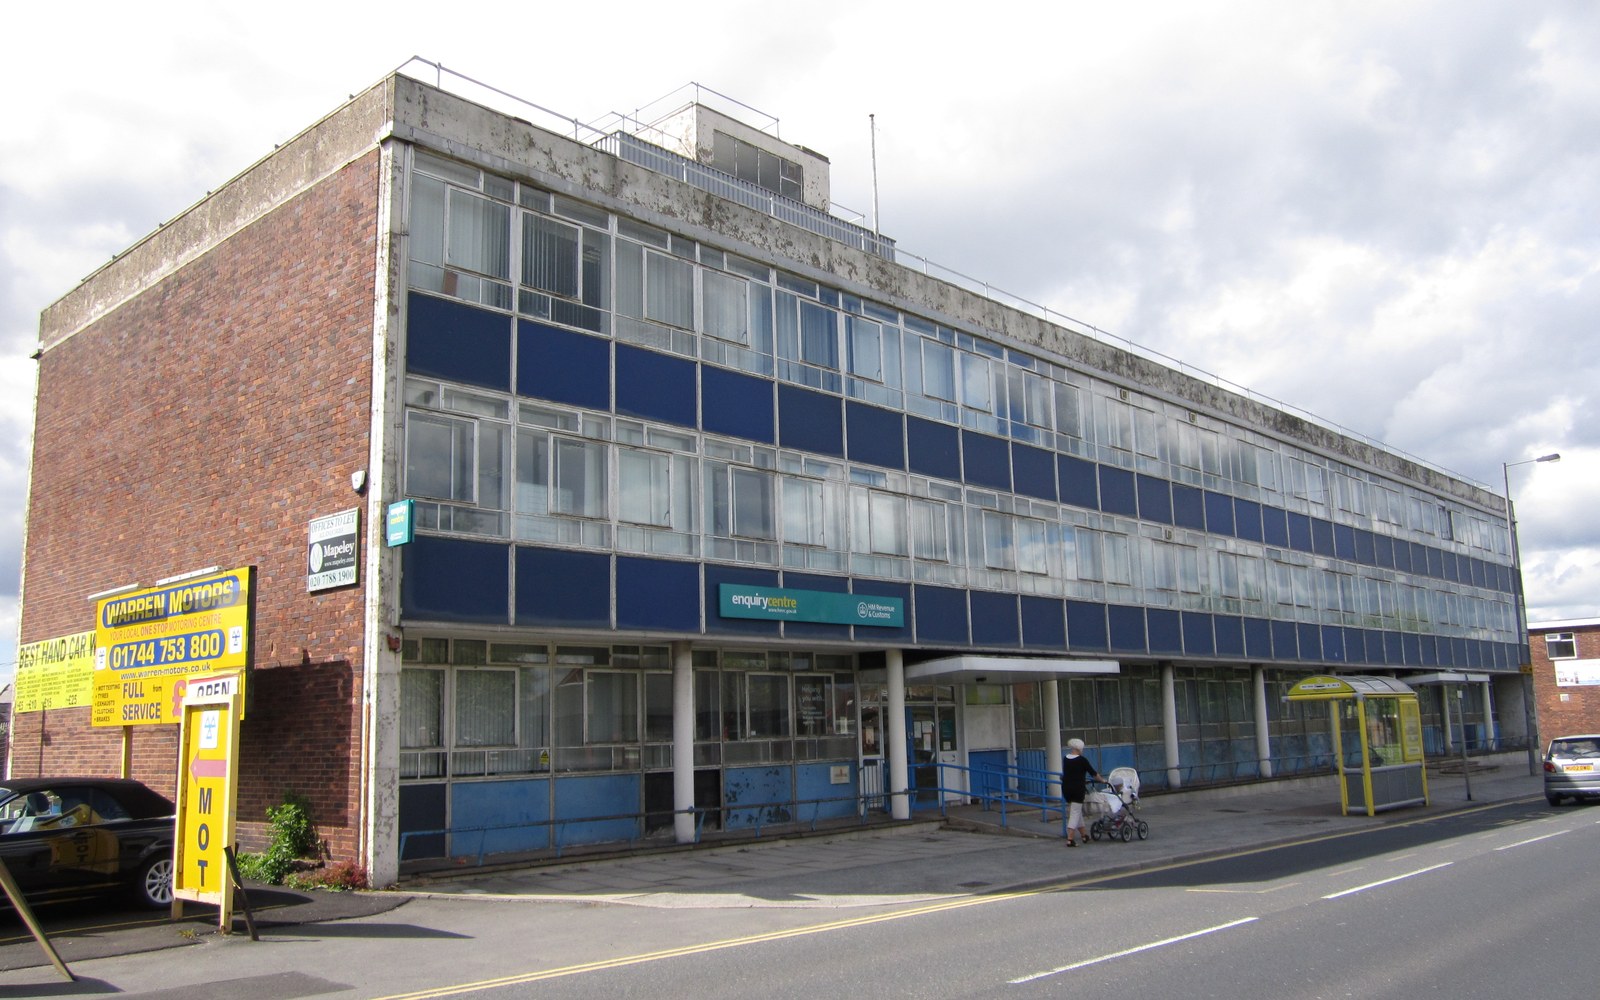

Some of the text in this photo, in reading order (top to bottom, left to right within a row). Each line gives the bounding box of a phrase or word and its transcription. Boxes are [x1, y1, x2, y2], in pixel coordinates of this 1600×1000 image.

[311, 520, 333, 533] OFFICES
[335, 517, 342, 527] TO
[343, 513, 355, 525] LET
[323, 540, 354, 558] Mapeley
[310, 569, 354, 587] 020 7788 1900
[106, 580, 233, 625] WARREN MOTORS
[110, 613, 222, 641] YOUR LOCAL ONE STOP MOTORING CENTRE
[19, 644, 40, 669] BEST
[41, 639, 67, 665] HAND
[69, 635, 86, 660] CAR
[113, 632, 220, 669] 01744 753 800
[120, 662, 211, 680] www.warren-motors.co.uk
[123, 682, 144, 699] FULL
[122, 702, 161, 721] SERVICE
